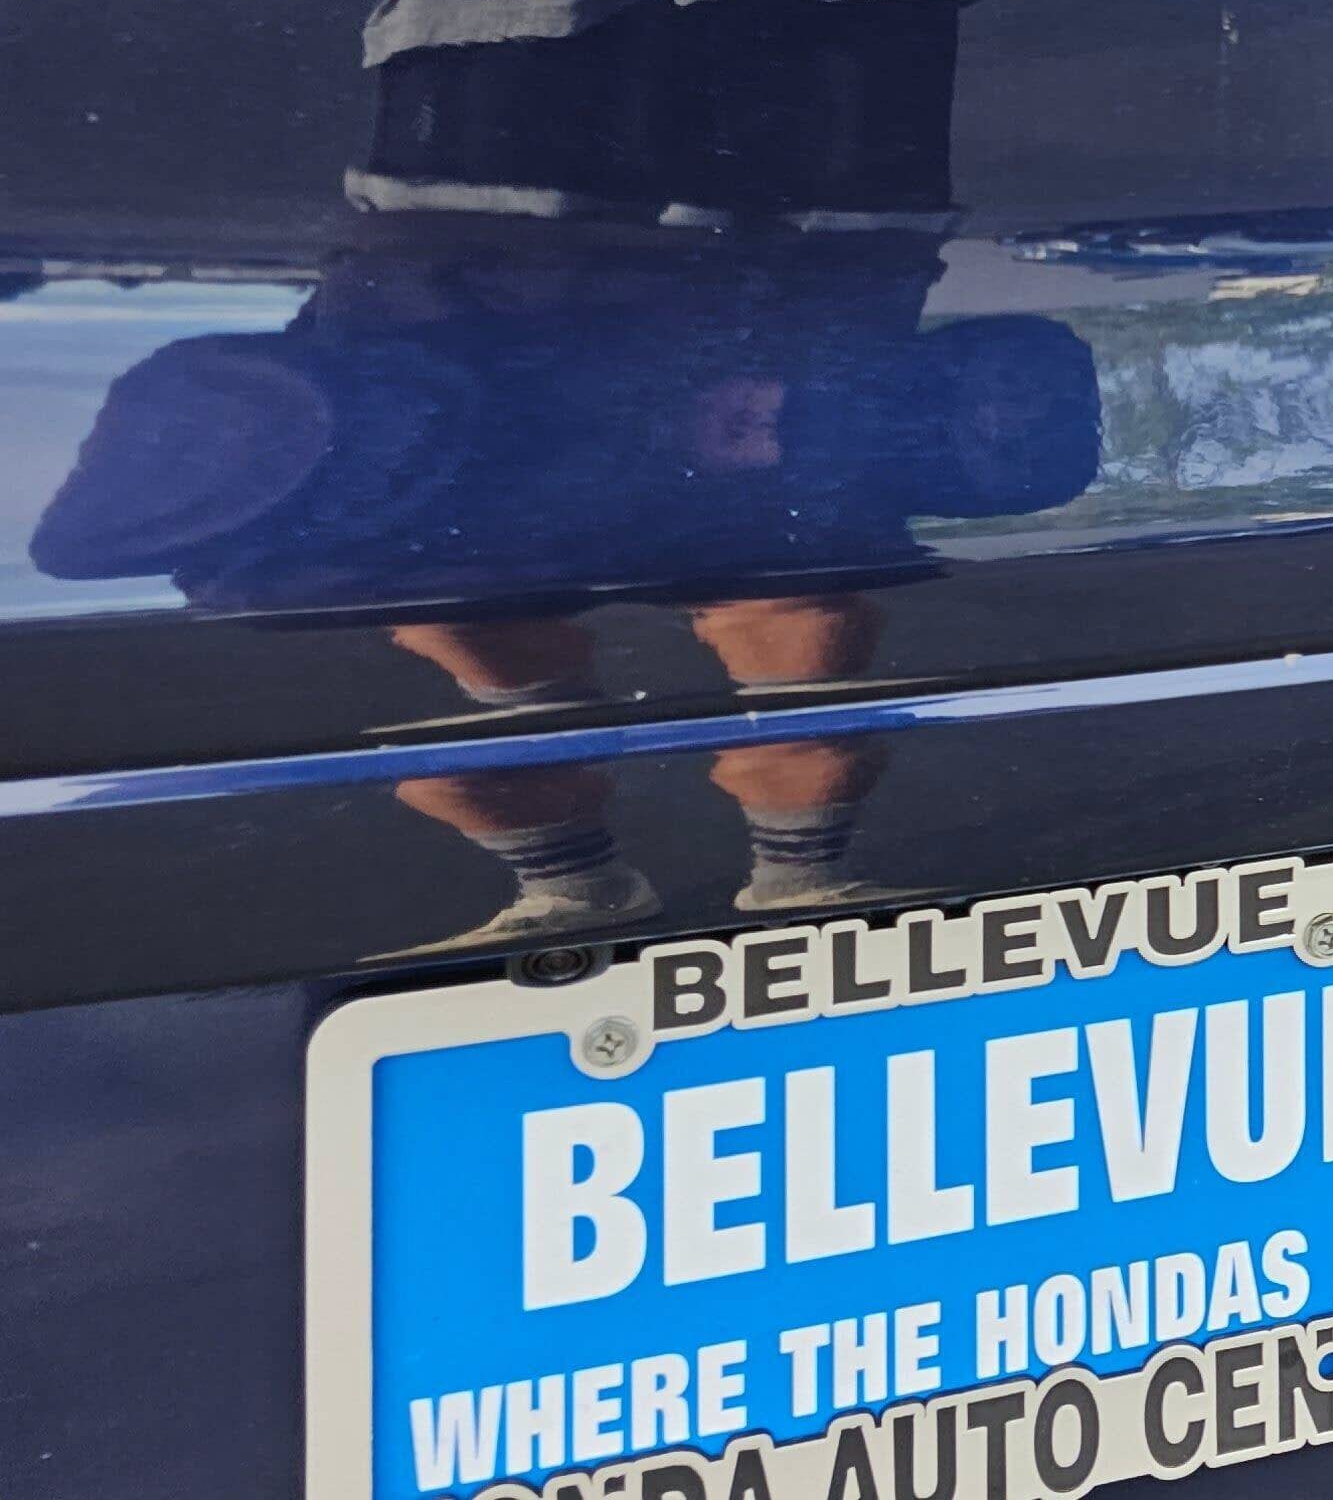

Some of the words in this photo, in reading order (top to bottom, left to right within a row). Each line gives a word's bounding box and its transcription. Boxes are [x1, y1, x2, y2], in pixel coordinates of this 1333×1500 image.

[652, 867, 1296, 1031] BELLEVUE
[409, 1339, 747, 1492] WHERE
[779, 1301, 941, 1417] THE
[977, 1239, 1310, 1379] HONDAS
[827, 1378, 1097, 1500] AUTO
